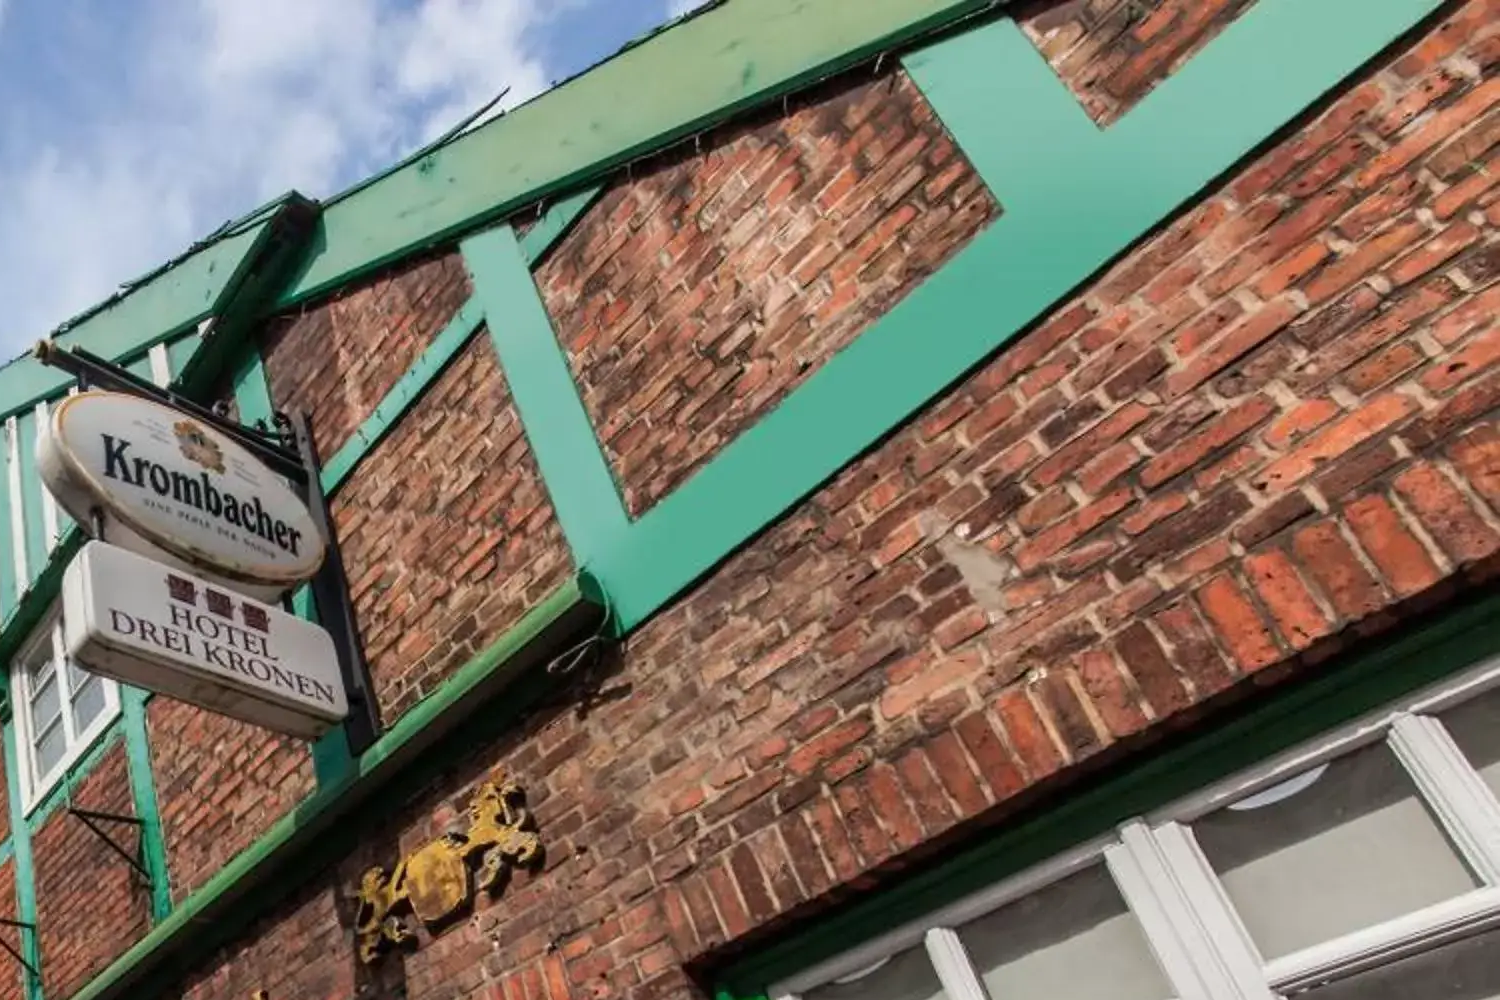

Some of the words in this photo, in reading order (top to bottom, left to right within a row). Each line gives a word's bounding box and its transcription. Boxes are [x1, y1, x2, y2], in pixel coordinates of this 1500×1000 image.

[101, 432, 303, 557] Krombacher
[109, 608, 194, 656] DREI
[204, 641, 336, 705] KRONEN
[170, 604, 279, 662] HOTEL
